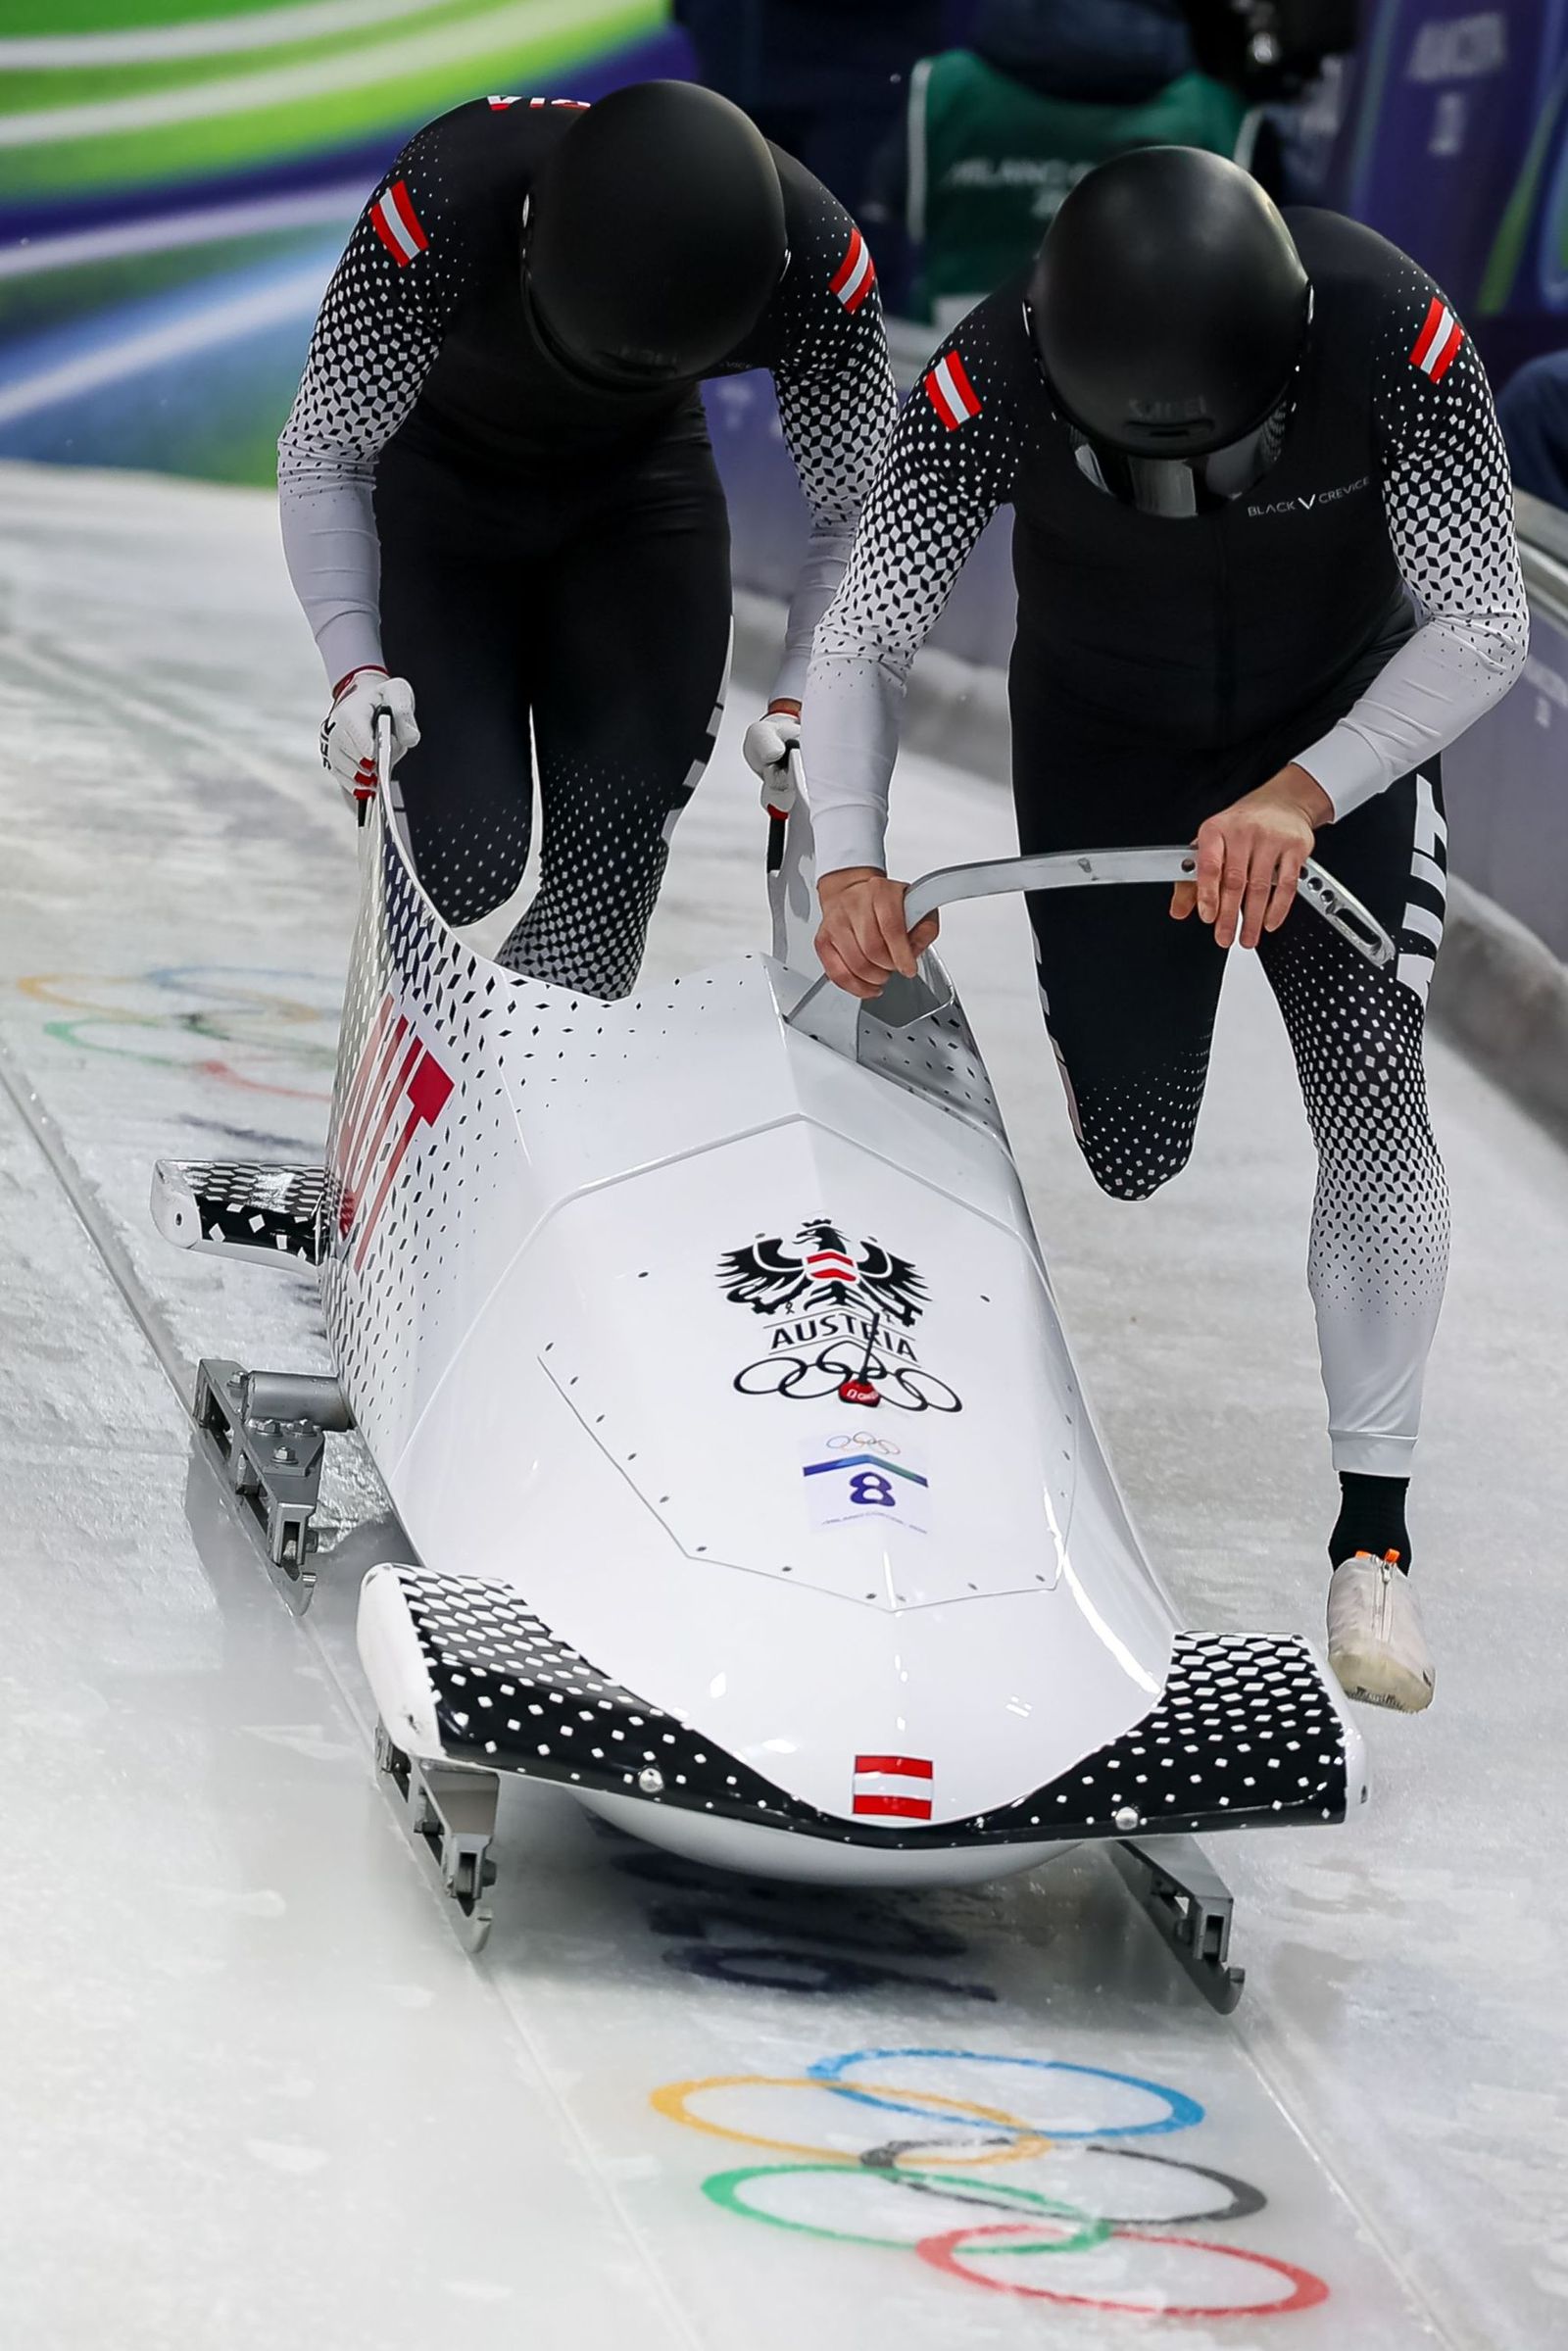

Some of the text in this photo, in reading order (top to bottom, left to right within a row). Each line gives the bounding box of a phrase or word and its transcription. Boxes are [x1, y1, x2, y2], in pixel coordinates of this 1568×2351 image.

[1247, 500, 1297, 517] BLACK
[1318, 475, 1370, 504] CREVICE
[770, 1312, 918, 1362] AUSTRIA
[849, 1471, 896, 1507] 8
